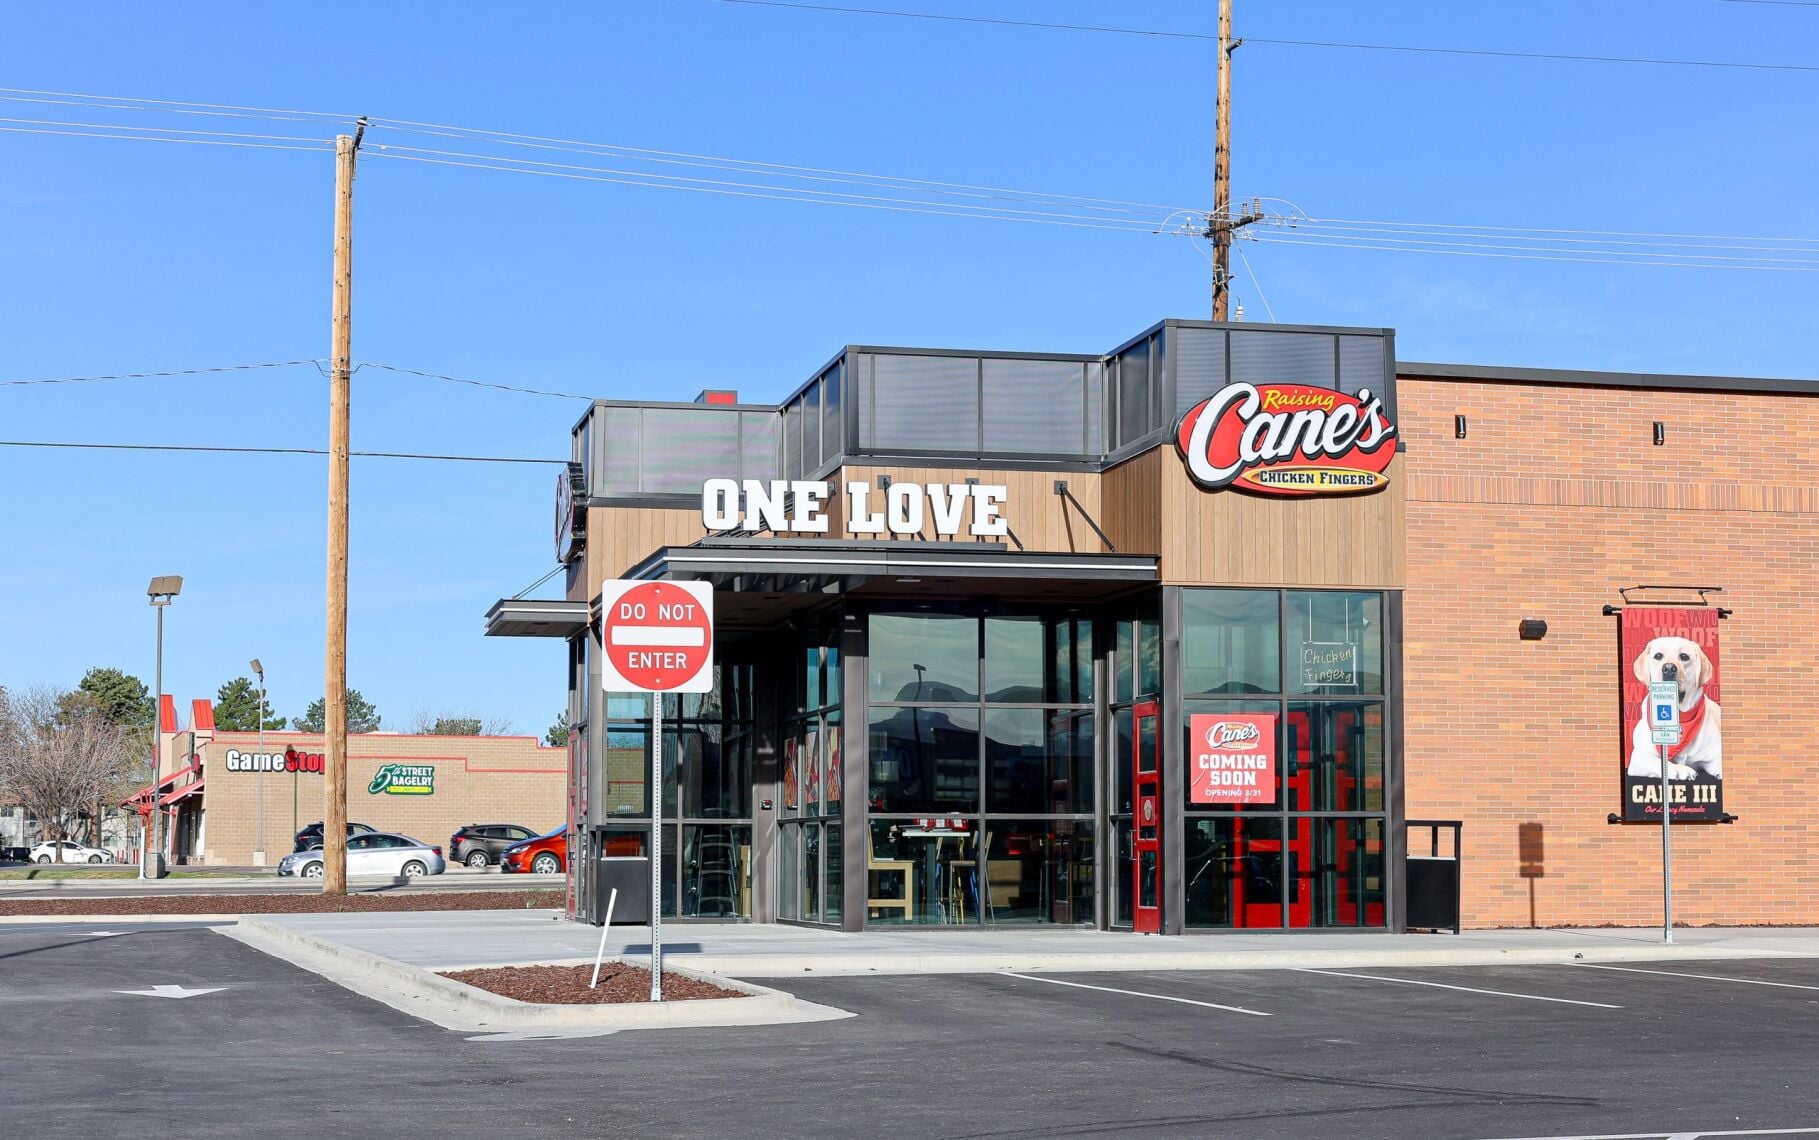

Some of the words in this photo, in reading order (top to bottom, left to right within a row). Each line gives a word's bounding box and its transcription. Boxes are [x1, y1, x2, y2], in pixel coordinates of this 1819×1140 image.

[1263, 389, 1335, 411] Raising
[1187, 381, 1394, 483] Cane's
[1259, 470, 1315, 485] CHICKEN
[1319, 471, 1374, 486] FINGERS
[702, 478, 828, 532] ONE
[847, 481, 1008, 536] LOVE
[620, 603, 646, 620] DO
[659, 604, 696, 621] NOT
[1622, 608, 1685, 628] WOOF
[628, 651, 687, 669] ENTER
[1304, 648, 1352, 665] Chicken
[1304, 667, 1352, 683] Fingers
[1209, 721, 1258, 748] Cane's
[1199, 754, 1267, 770] COMING
[402, 767, 433, 776] STREET
[1210, 770, 1257, 786] SOON
[392, 776, 433, 786] BAGELRY
[1205, 789, 1243, 797] OPENING
[1244, 789, 1261, 797] 3/31
[1693, 784, 1718, 803] III
[1644, 805, 1657, 813] Our
